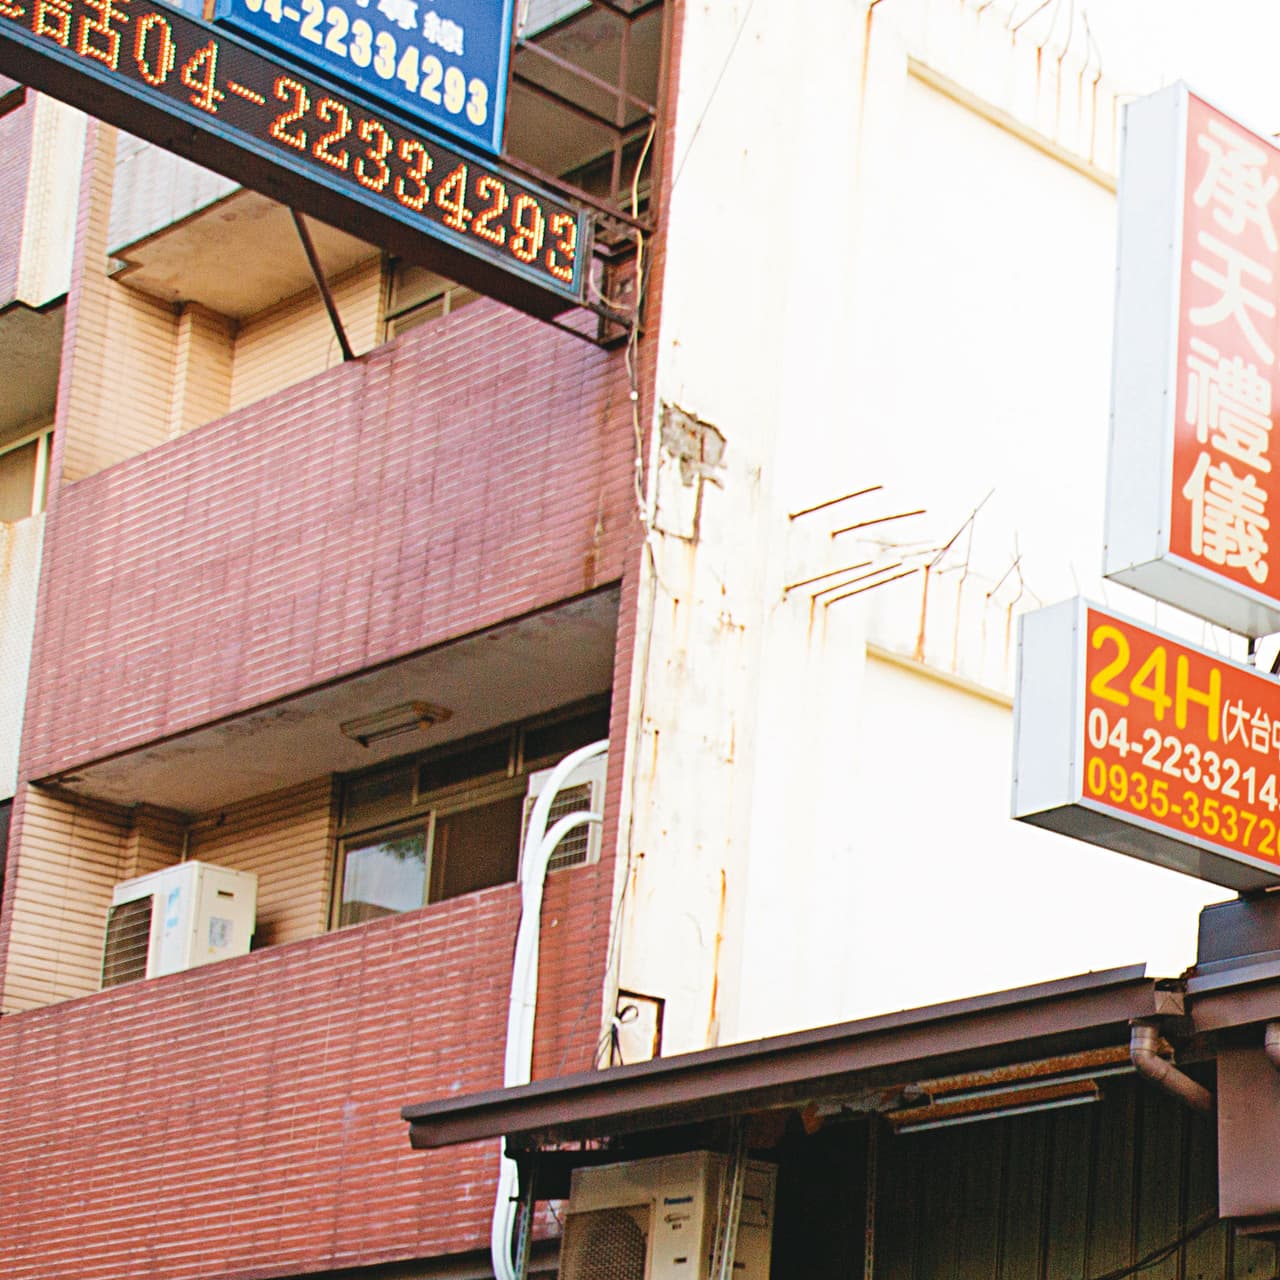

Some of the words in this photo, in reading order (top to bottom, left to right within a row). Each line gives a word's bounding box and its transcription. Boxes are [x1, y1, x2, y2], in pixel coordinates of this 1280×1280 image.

[245, 0, 488, 126] -22334293
[1183, 119, 1280, 585] 承天禮儀
[1090, 625, 1221, 742] 24H
